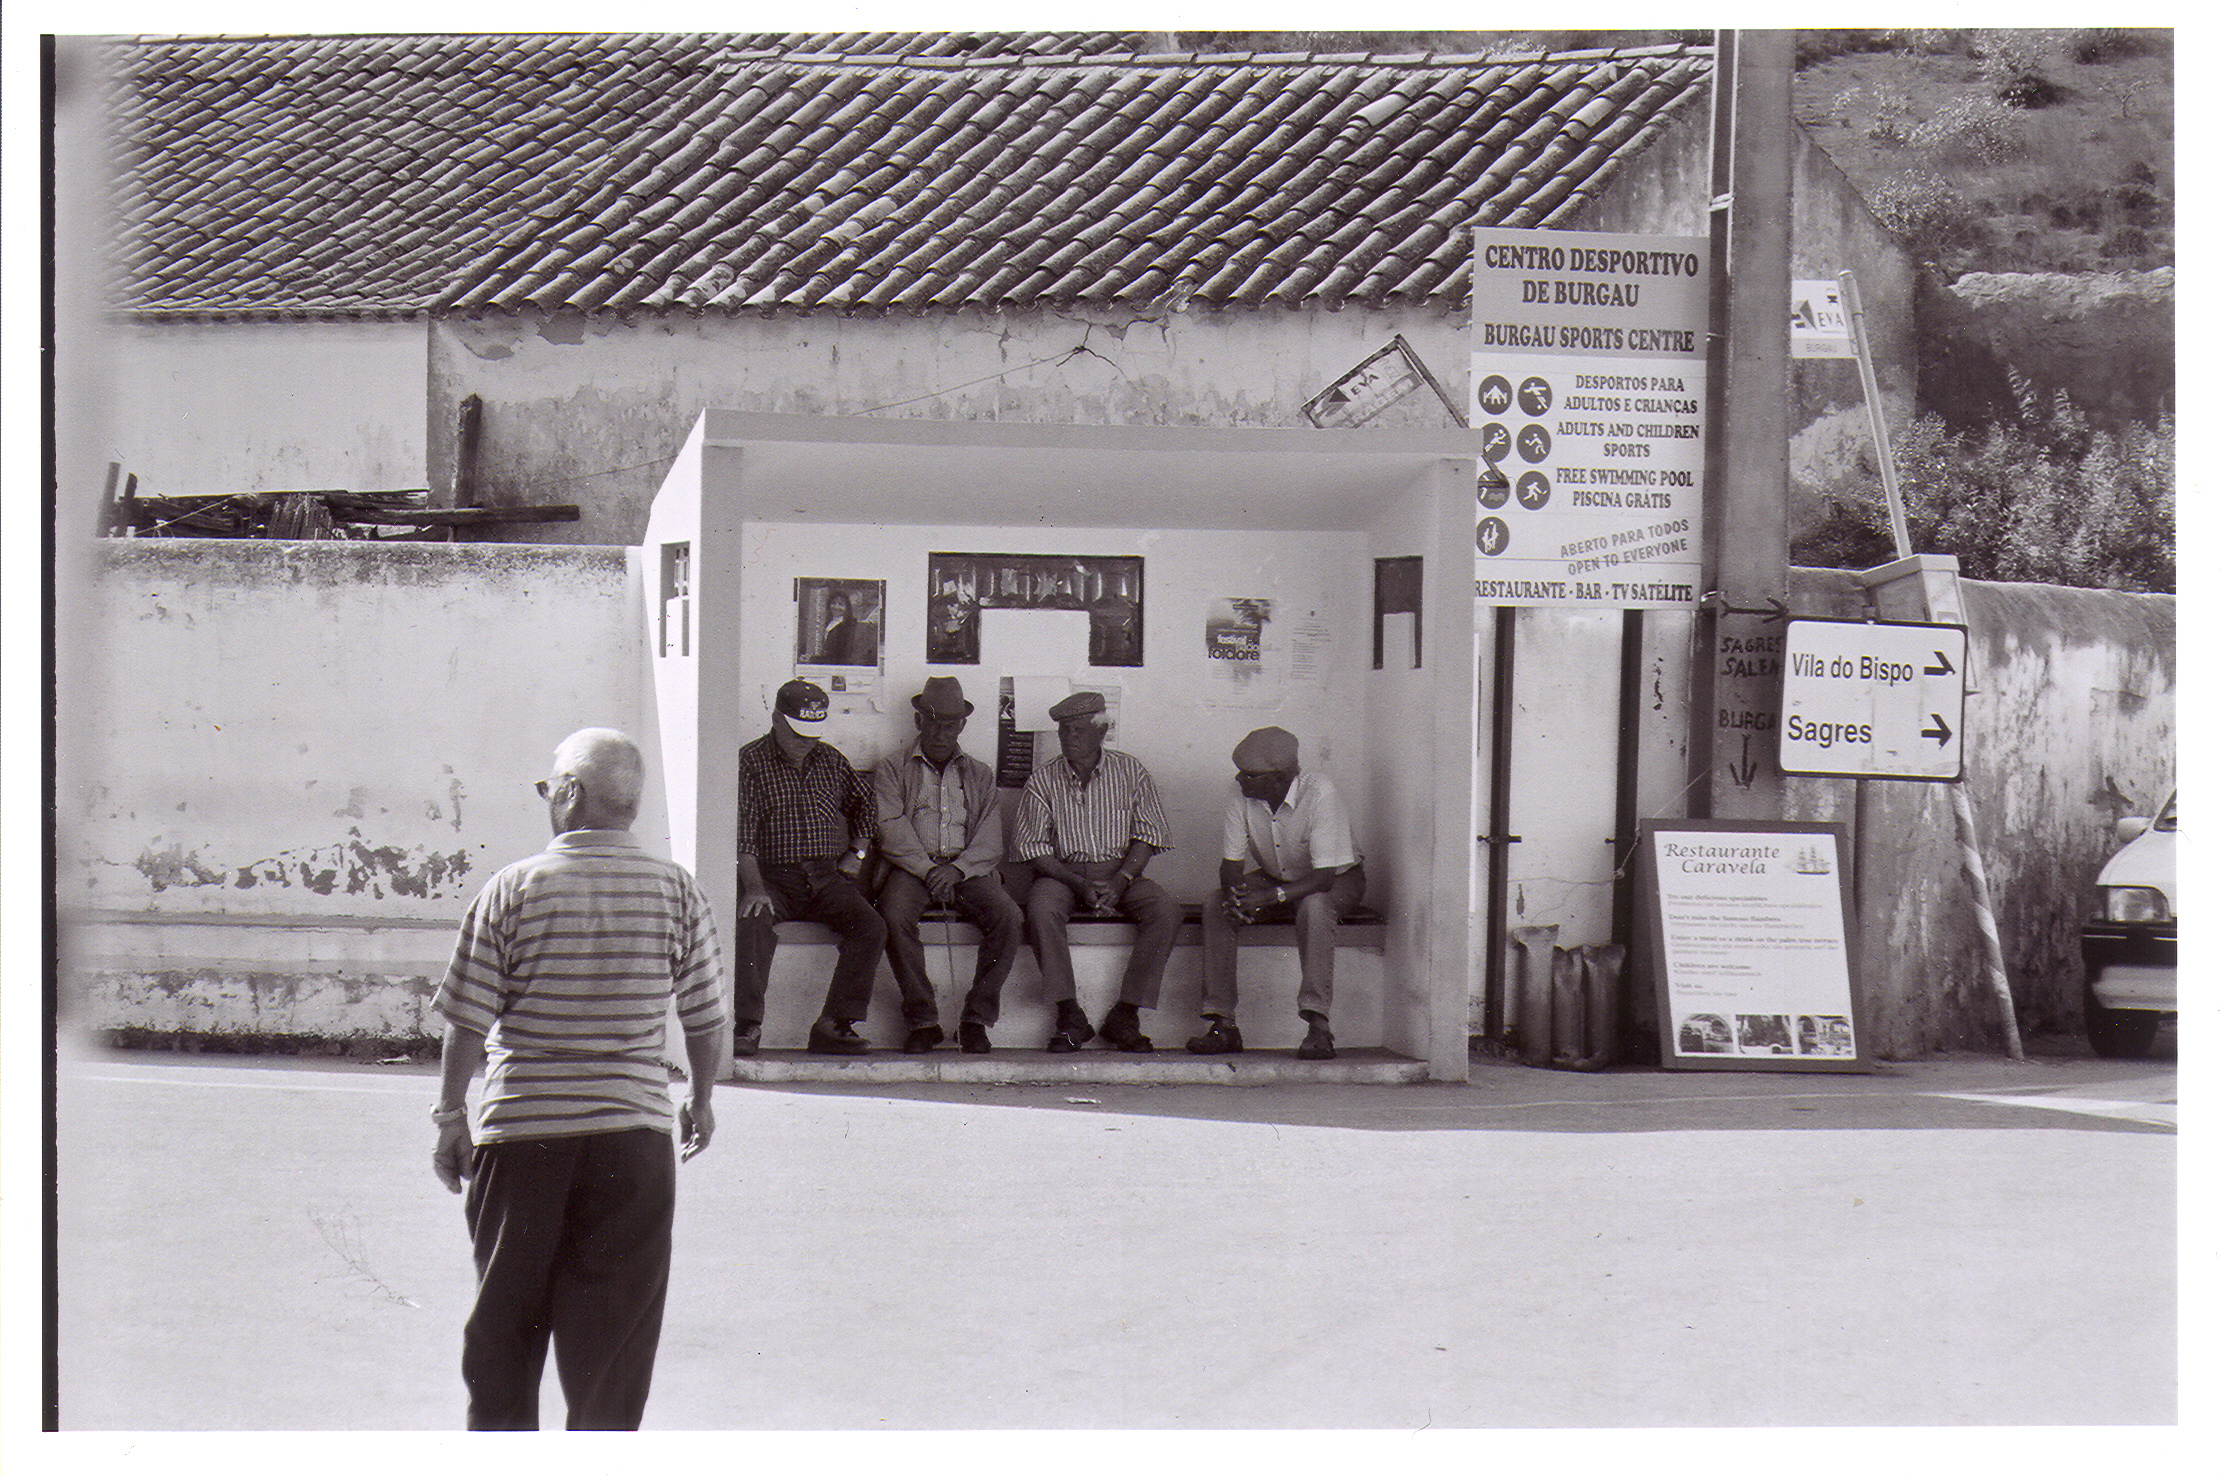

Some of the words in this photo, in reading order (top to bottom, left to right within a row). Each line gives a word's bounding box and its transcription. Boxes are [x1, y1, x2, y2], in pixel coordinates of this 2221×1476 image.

[1485, 244, 1565, 270] CENTRO
[1569, 248, 1699, 277] DESPORTIVO
[1522, 280, 1549, 303] DE
[1554, 281, 1640, 307] BURGAU
[1817, 312, 1845, 327] EVA
[1484, 323, 1555, 347] BURGAU
[1559, 326, 1624, 349] SPORTS
[1628, 329, 1695, 352] CENTRE
[1575, 375, 1647, 390] DESPORTOS
[1651, 378, 1685, 392] PARA
[1564, 396, 1620, 411] ADULTOS
[1624, 399, 1632, 412] E
[1634, 399, 1698, 417] CRIANÇAS
[1556, 422, 1605, 436] ADULTS
[1607, 424, 1634, 437] AND
[1636, 425, 1700, 439] CHILDREN
[1603, 444, 1651, 458] SPORTS
[1556, 468, 1586, 484] FREE
[1589, 469, 1657, 486] SWIMMING
[1660, 471, 1694, 487] POOL
[1572, 490, 1622, 507] PISCINA
[1625, 489, 1672, 509] GRÁTIS
[1560, 537, 1608, 559] ABERTO
[1611, 528, 1645, 545] PARA
[1648, 518, 1690, 538] TODOS
[1567, 557, 1600, 576] OPEN
[1604, 553, 1620, 567] TO
[1623, 537, 1689, 564] EVERYONE
[1475, 580, 1567, 599] RESTAURANTE
[1576, 582, 1603, 600] BAR
[1612, 583, 1630, 600] TV
[1631, 579, 1693, 602] SATÉLITE
[1793, 653, 1825, 677] Vila
[1830, 655, 1853, 679] do
[1860, 656, 1914, 687] Bispo
[1787, 715, 1872, 748] Sagres
[1664, 843, 1780, 858] Restaurante
[1681, 859, 1766, 874] Caravela
